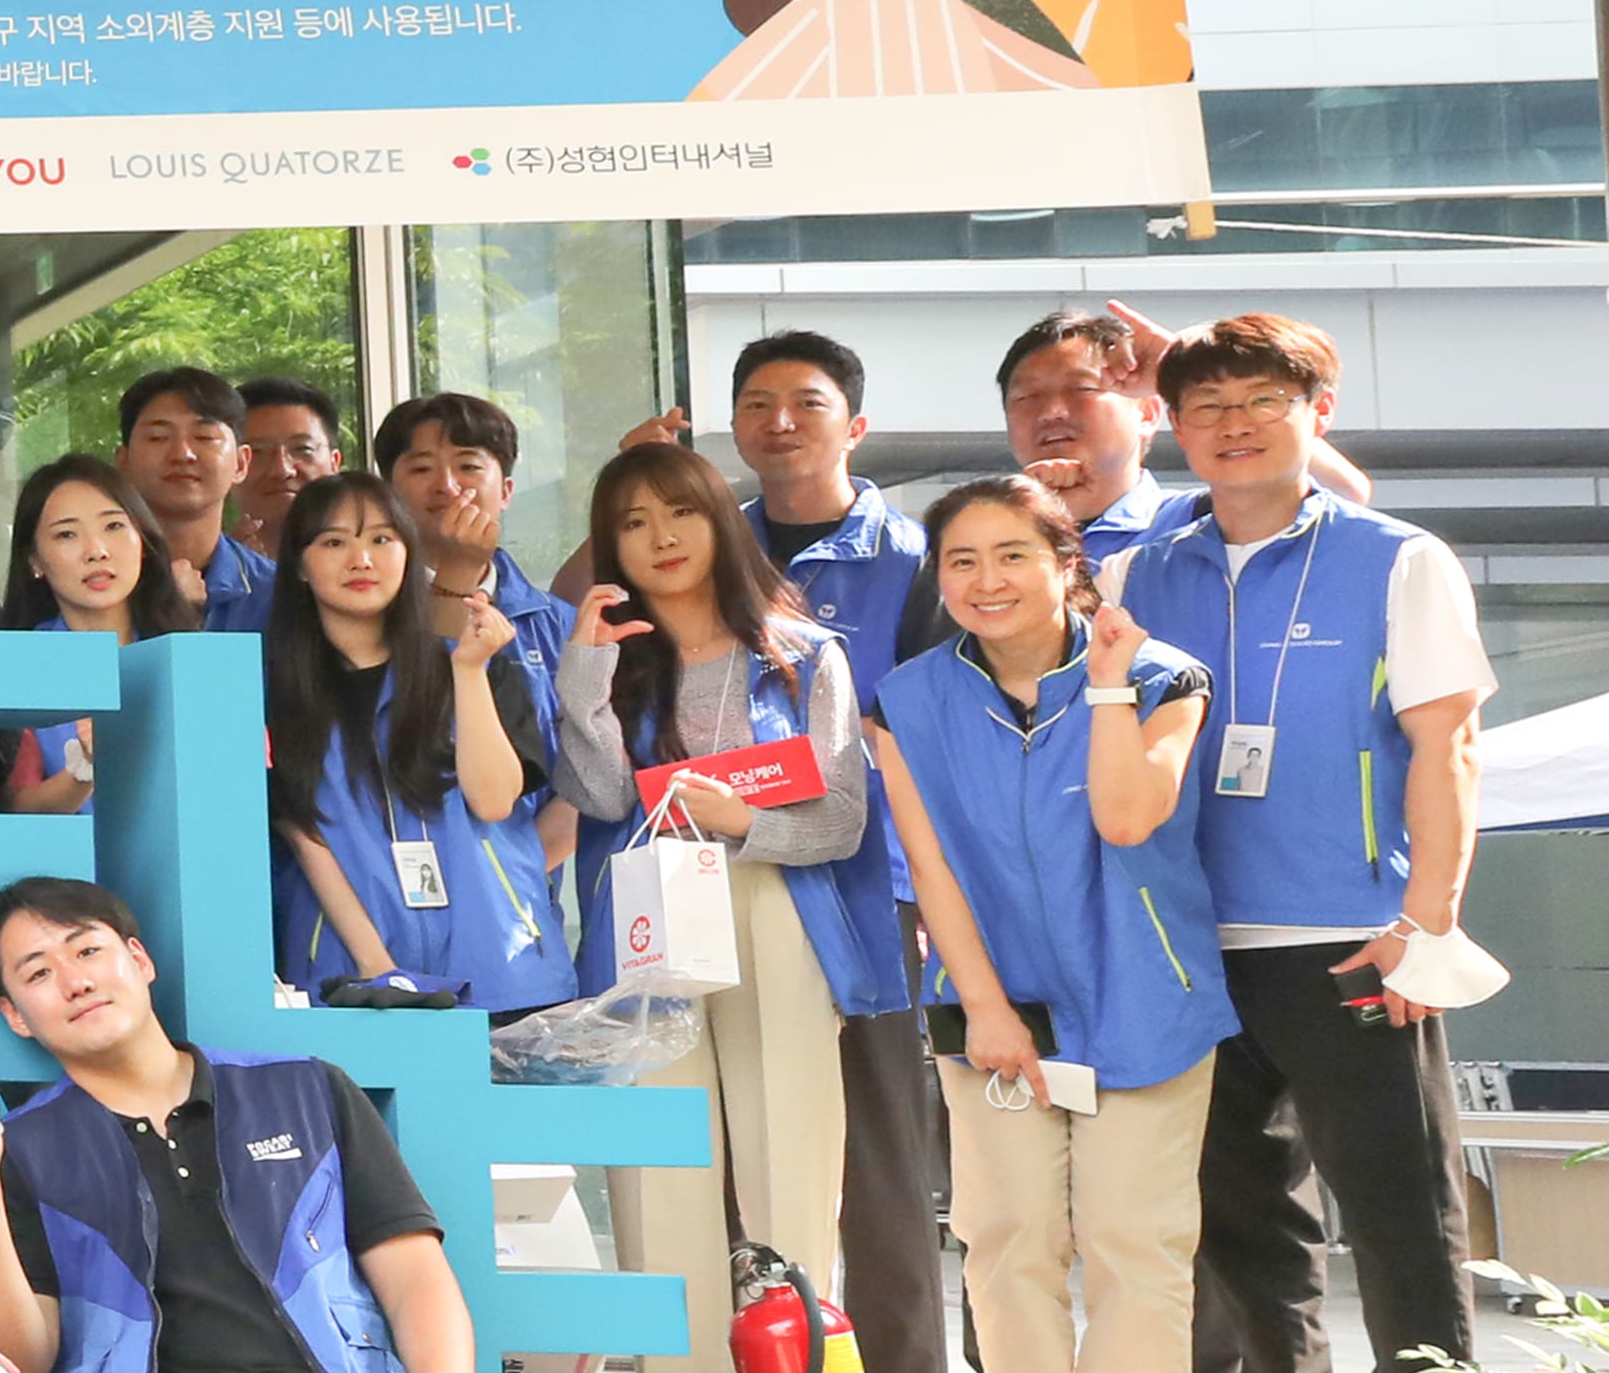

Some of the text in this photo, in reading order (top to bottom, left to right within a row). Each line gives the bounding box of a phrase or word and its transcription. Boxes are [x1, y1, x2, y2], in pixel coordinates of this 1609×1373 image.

[27, 14, 85, 44] 지역
[97, 11, 215, 41] 소외계층
[225, 9, 283, 39] 지원
[294, 7, 353, 38] 등에
[364, 3, 521, 36] 사용됩니다.
[111, 150, 403, 183] LOUIS QUATORZE
[507, 144, 771, 172] (주)성현인터내셔널
[729, 763, 784, 786] 모닝케어
